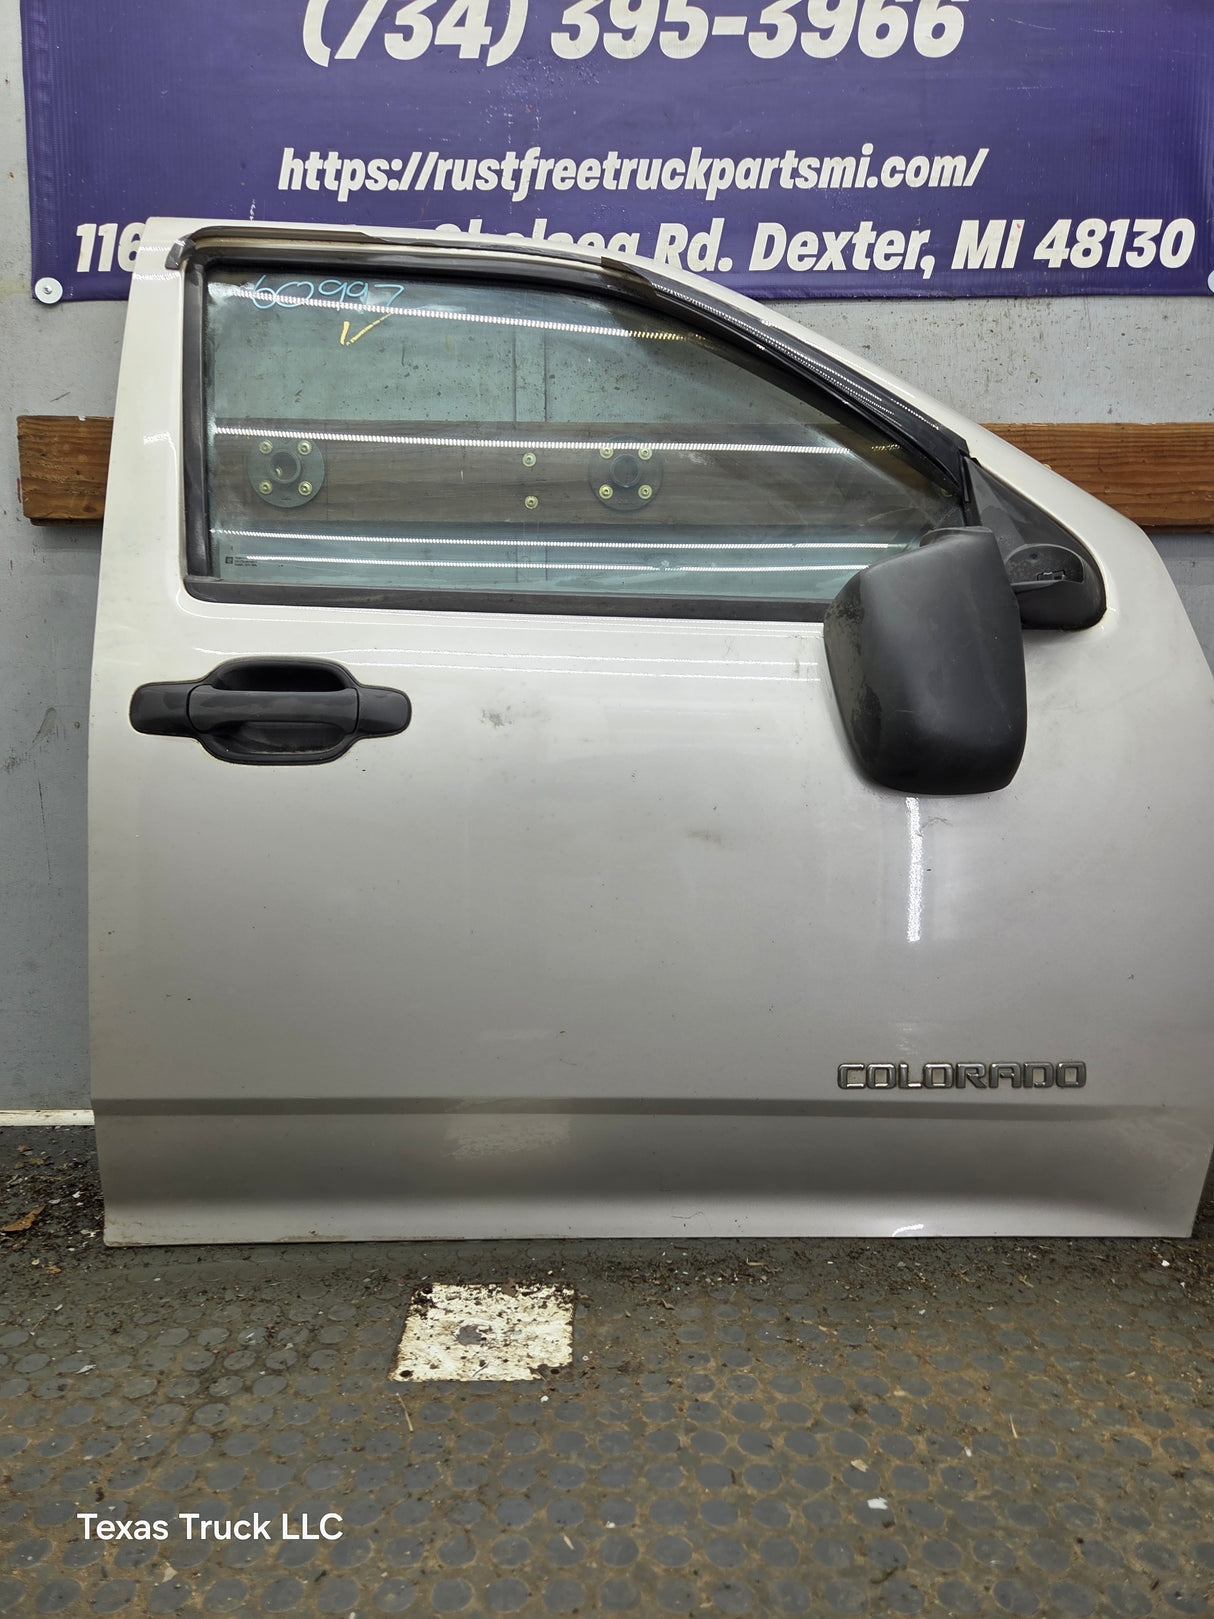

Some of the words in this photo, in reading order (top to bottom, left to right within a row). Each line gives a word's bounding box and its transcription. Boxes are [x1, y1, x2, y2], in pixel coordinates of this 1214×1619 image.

[550, 0, 969, 60] 395-3966
[277, 143, 990, 203] https://rustfreetruckpartsmi.com/
[653, 217, 734, 273] Rd.
[748, 221, 932, 280] Dexter,
[951, 219, 1025, 270] MI
[1033, 218, 1196, 269] 48130
[250, 274, 405, 314] 60997
[837, 1062, 1087, 1090] COLORADO
